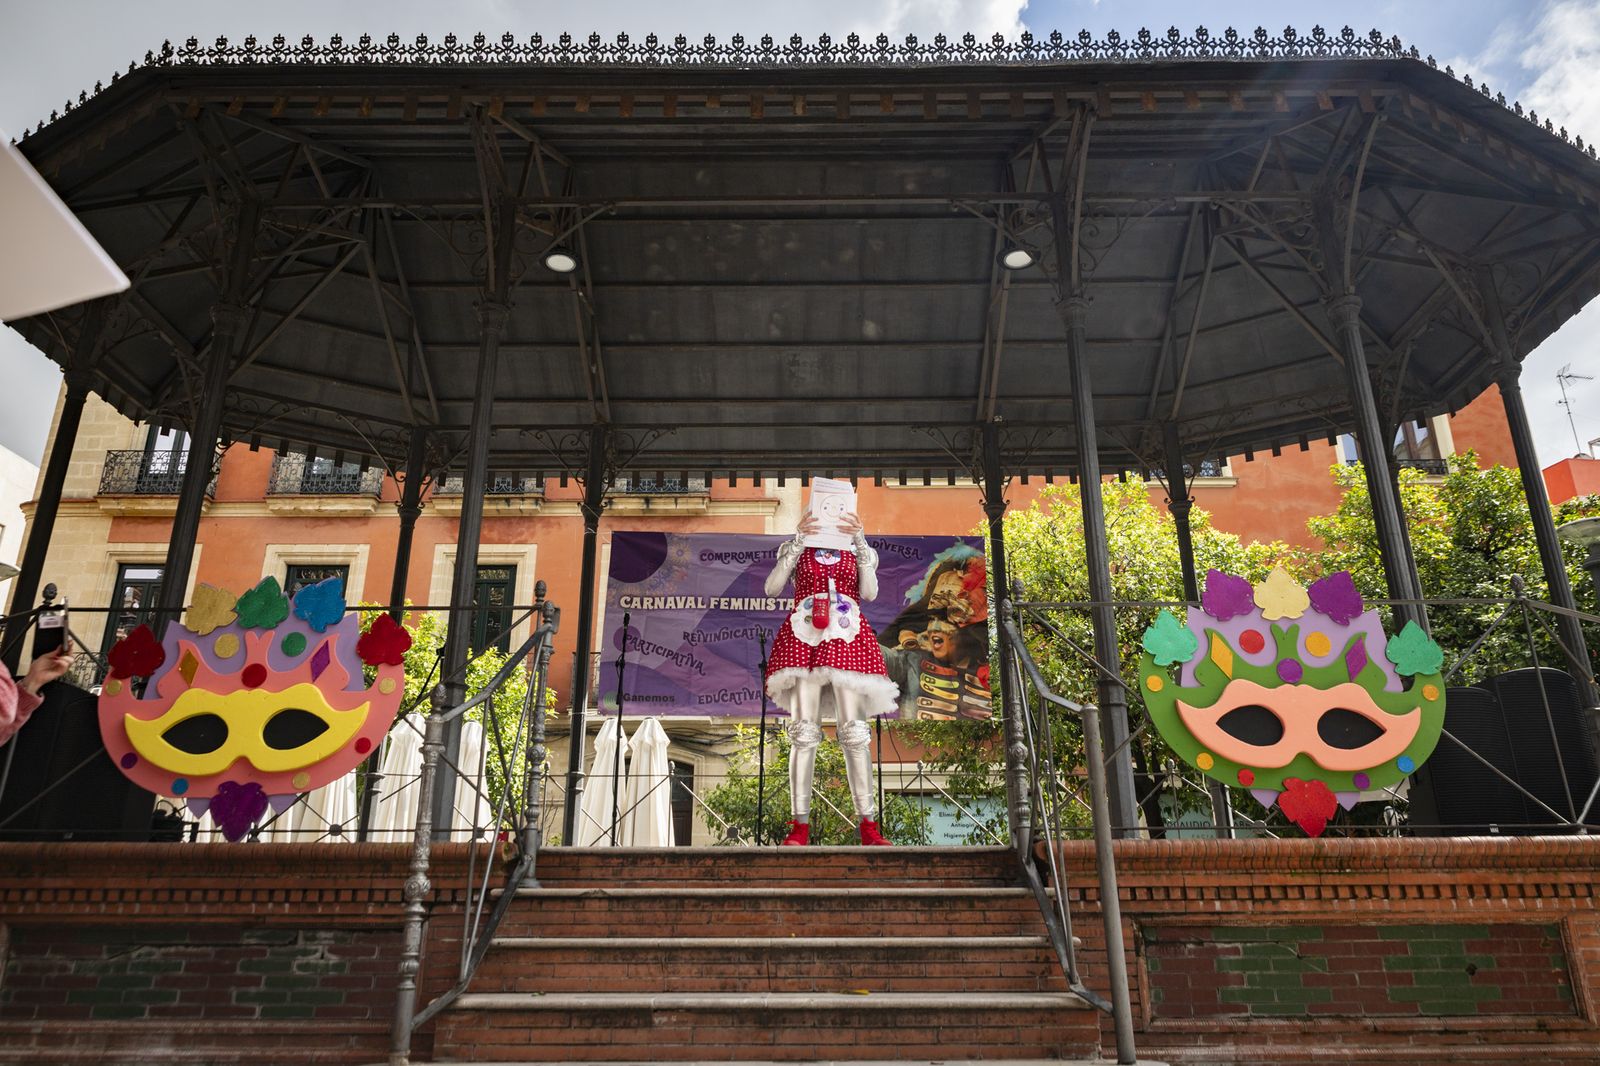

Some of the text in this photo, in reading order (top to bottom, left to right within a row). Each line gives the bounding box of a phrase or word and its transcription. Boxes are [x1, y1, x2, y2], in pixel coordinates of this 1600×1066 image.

[700, 551, 778, 564] COMPROMETID
[872, 538, 923, 560] DIVERSA
[620, 596, 795, 611] CARNAVAL FEMINISTA
[625, 634, 706, 677] PARTICIPATIVA
[623, 693, 676, 703] Ganemos
[698, 687, 763, 706] EDUCATIVA
